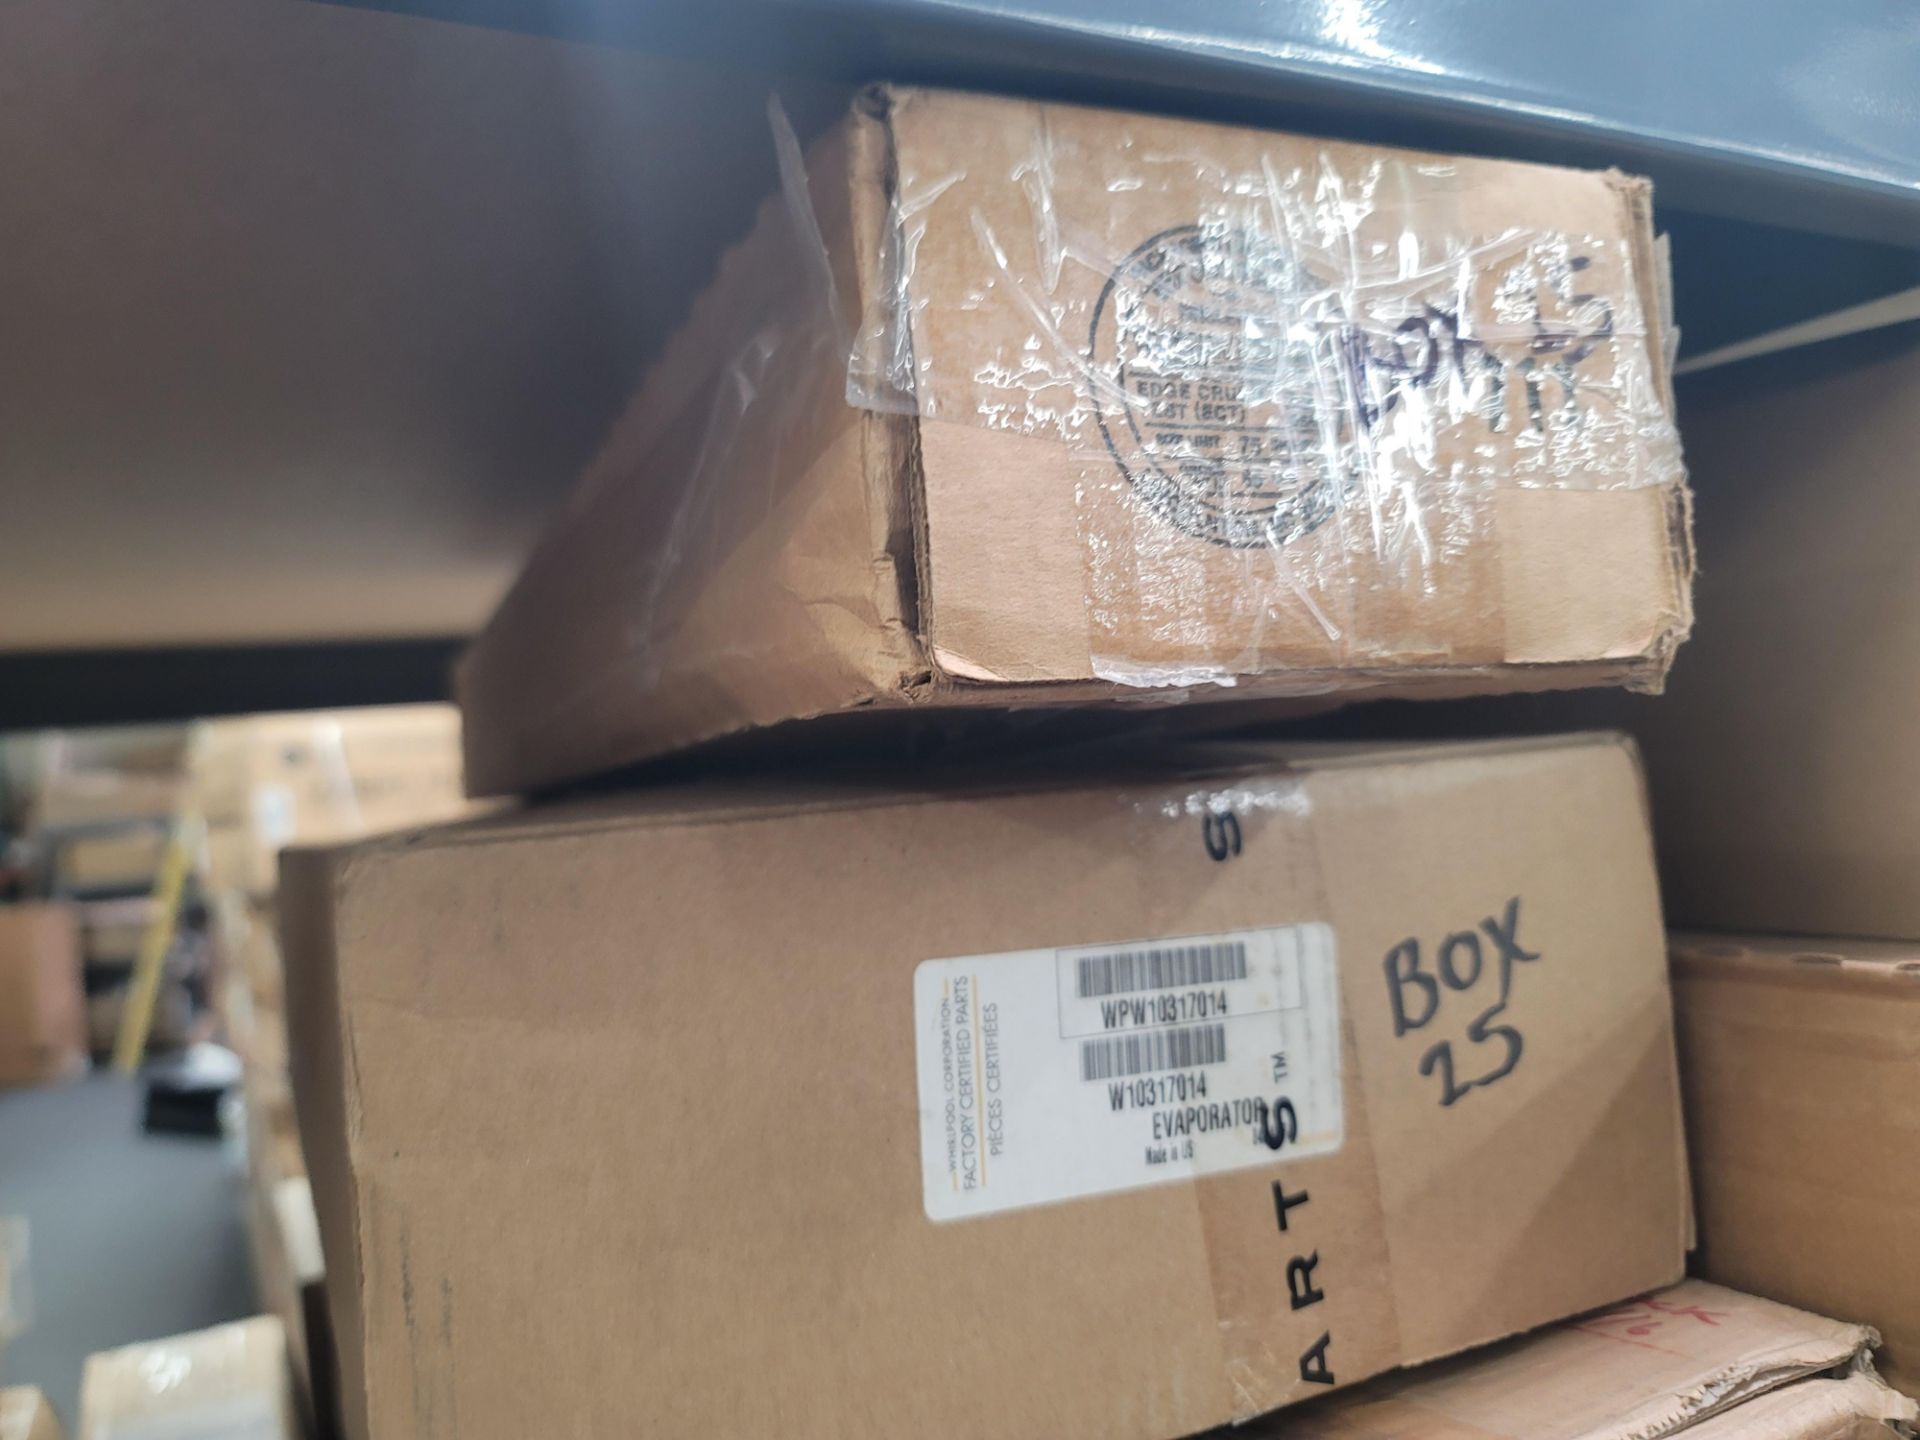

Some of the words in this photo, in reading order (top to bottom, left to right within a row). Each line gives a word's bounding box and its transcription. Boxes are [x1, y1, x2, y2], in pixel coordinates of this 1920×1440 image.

[953, 974, 969, 1025] PARTS
[1383, 895, 1542, 1038] BOX
[940, 997, 955, 1093] CORPORATION
[982, 1001, 1002, 1094] CERTIFIÉES
[1101, 988, 1227, 1029] WPW10317014
[955, 1028, 974, 1111] CERTIFIED
[1108, 1070, 1207, 1111] W10317014
[1418, 1005, 1524, 1107] 25
[943, 1097, 957, 1173] WHIRLPOOL
[959, 1114, 978, 1192] FACTORY
[984, 1098, 1004, 1157] PIÈCES
